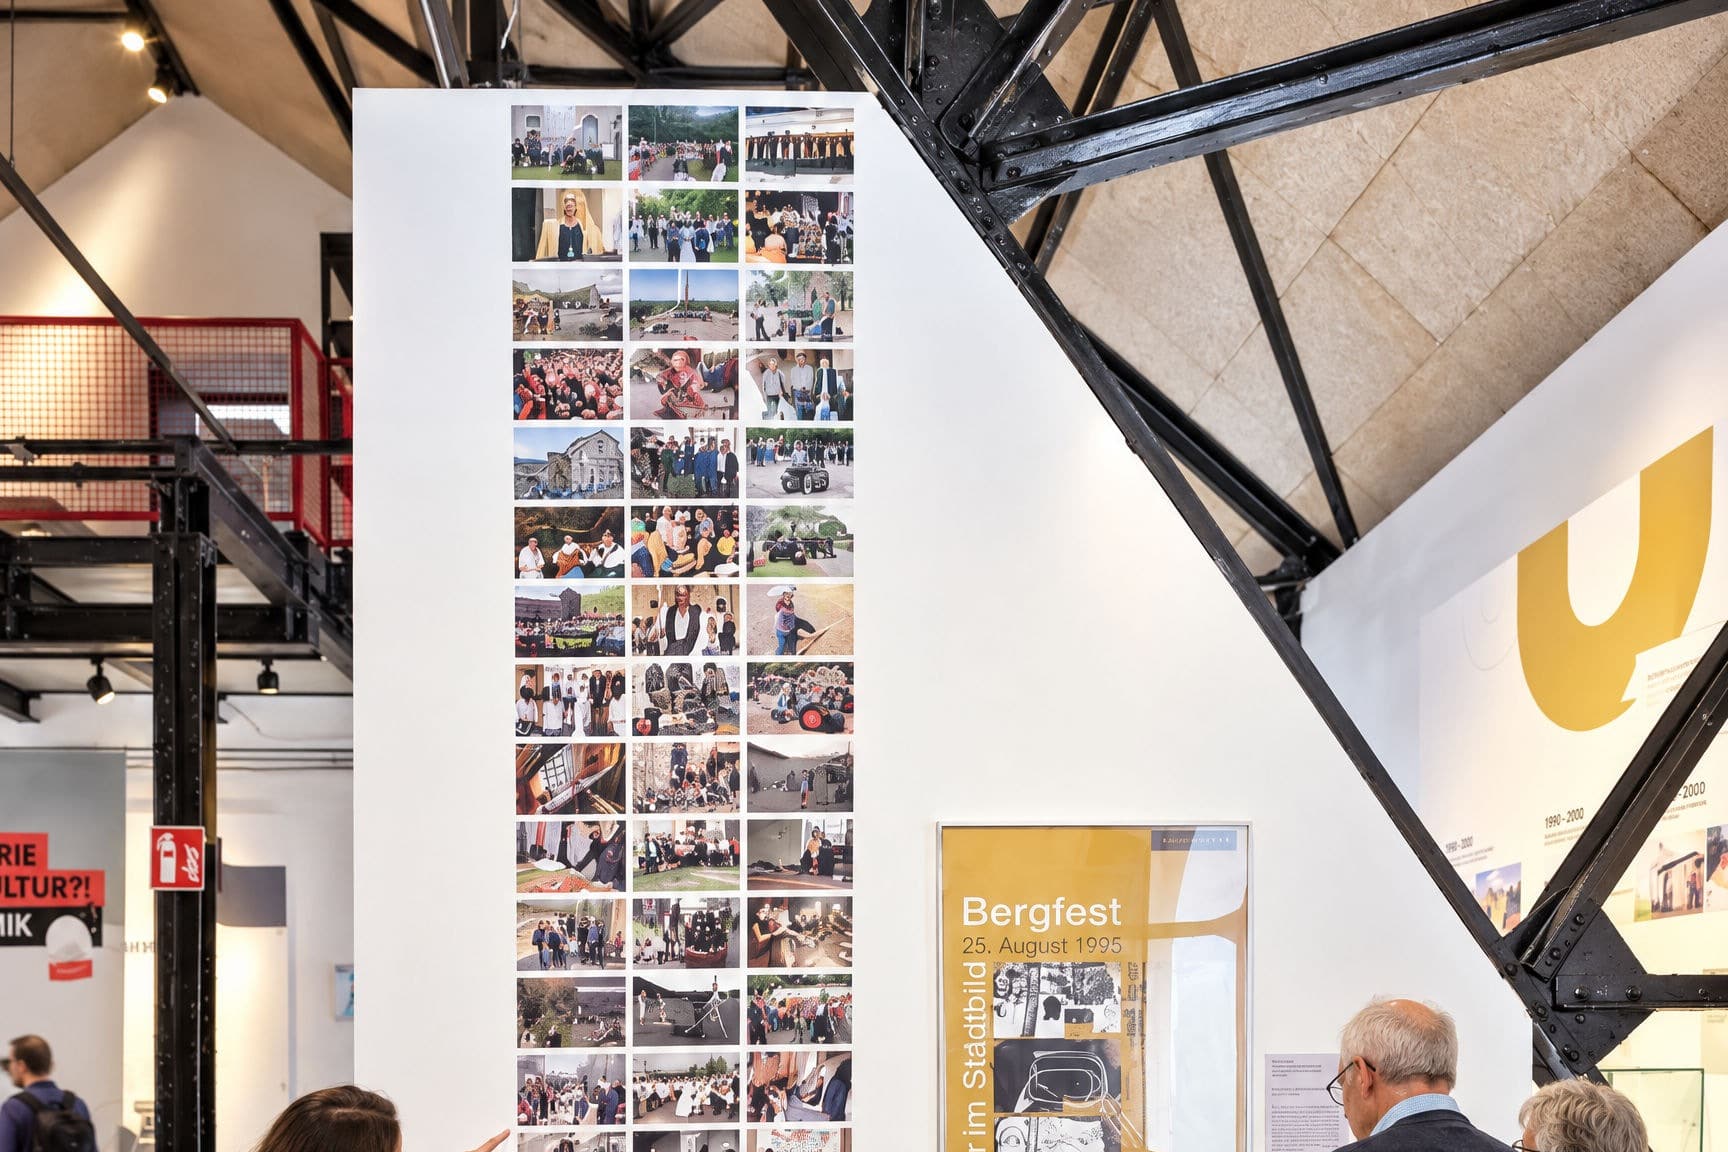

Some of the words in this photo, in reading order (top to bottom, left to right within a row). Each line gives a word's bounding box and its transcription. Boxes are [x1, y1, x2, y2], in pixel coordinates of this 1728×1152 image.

[0, 876, 90, 898] LTUR?!
[0, 913, 33, 937] IK
[962, 896, 1122, 933] Bergfest
[962, 937, 991, 954] 25.
[998, 937, 1068, 959] August
[1076, 937, 1122, 954] 1995
[962, 1101, 987, 1136] im
